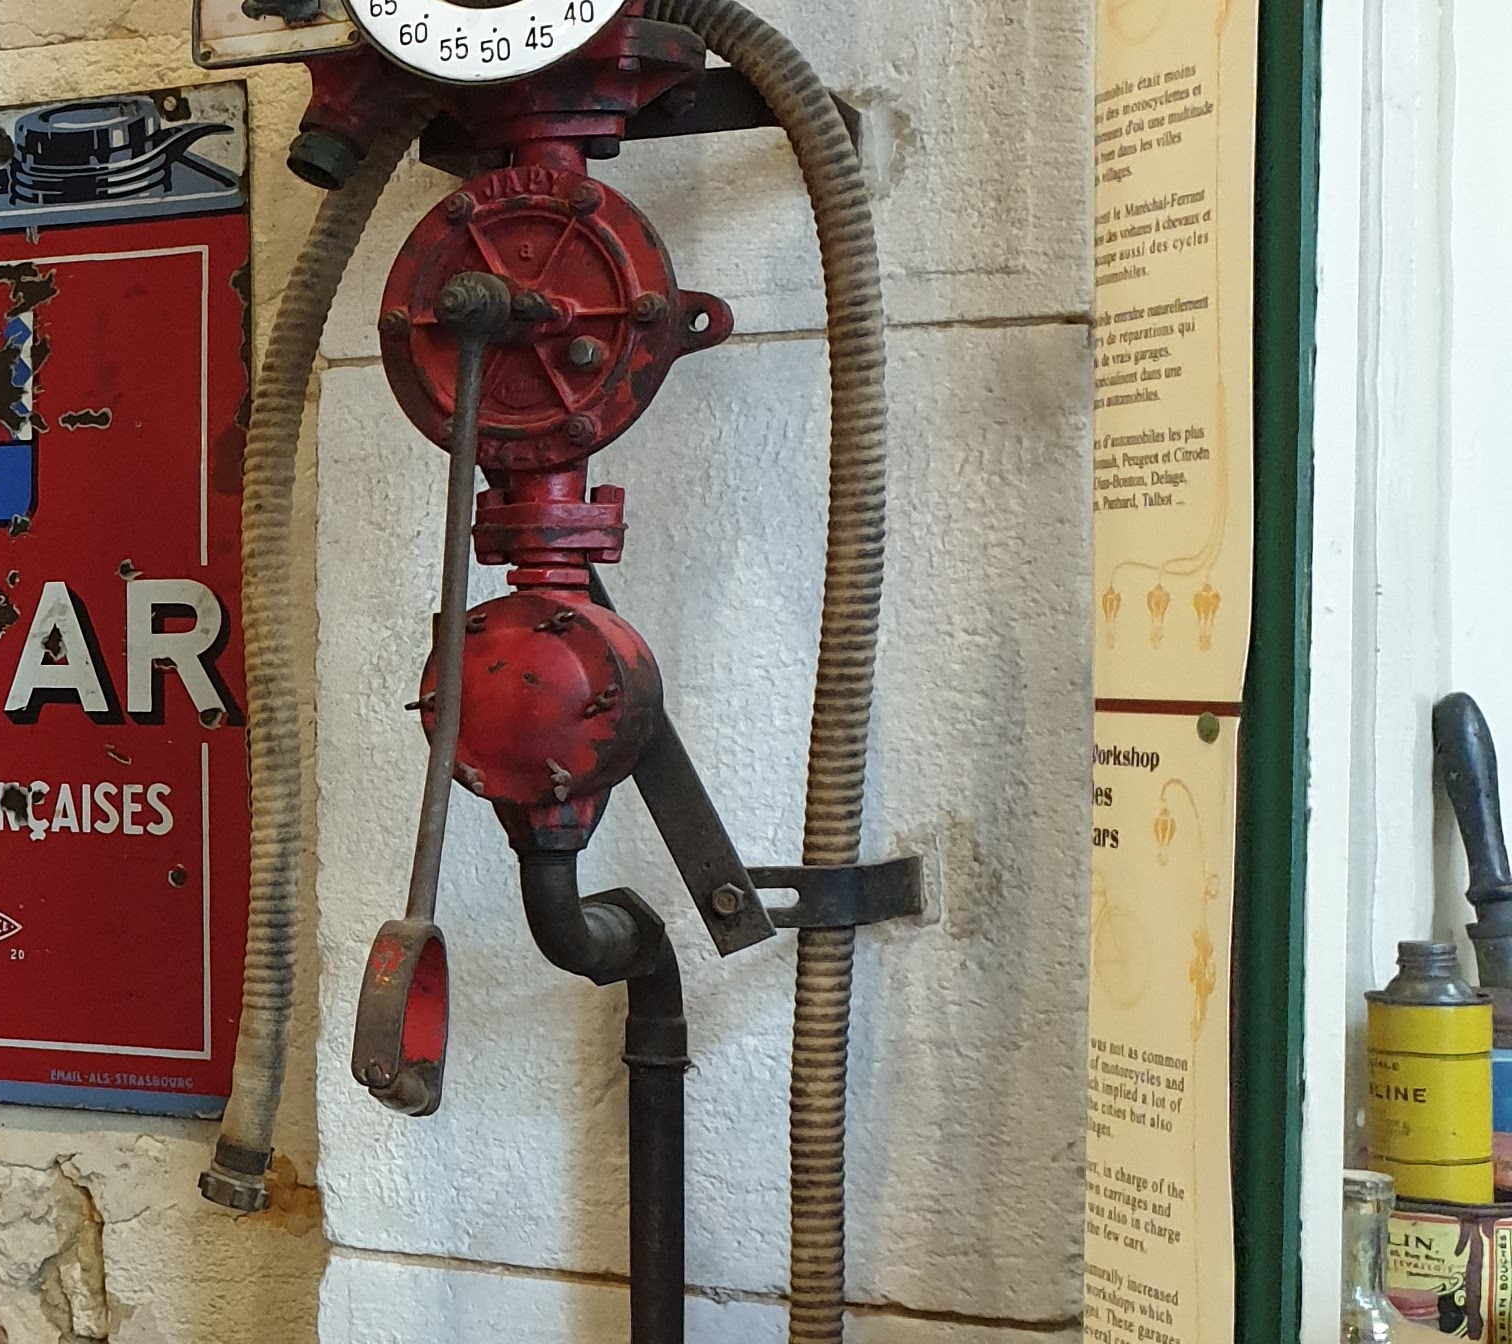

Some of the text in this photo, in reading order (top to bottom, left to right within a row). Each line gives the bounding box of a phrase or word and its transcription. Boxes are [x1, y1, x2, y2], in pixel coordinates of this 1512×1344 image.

[563, 0, 595, 24] 40
[399, 21, 429, 46] 60
[524, 24, 554, 51] 45
[439, 36, 469, 63] 55
[480, 37, 512, 64] 50
[1164, 65, 1197, 84] moins
[1149, 239, 1168, 255] des
[1172, 229, 1210, 254] cycles
[1185, 425, 1205, 444] plus
[9, 948, 26, 961] 20
[1128, 1046, 1138, 1060] as
[1142, 1051, 1188, 1071] common
[1102, 1061, 1162, 1086] motorcycles
[1166, 1076, 1185, 1093] and
[1102, 1079, 1138, 1103] implied
[1142, 1093, 1148, 1105] a
[1152, 1090, 1166, 1109] lot
[1170, 1097, 1183, 1113] of
[1101, 1102, 1172, 1133] cities but also
[1104, 1160, 1112, 1178] in
[1115, 1166, 1148, 1192] charge
[1152, 1178, 1165, 1194] of
[1168, 1181, 1185, 1200] the
[1104, 1186, 1148, 1212] carriages
[1152, 1202, 1171, 1218] and
[1104, 1223, 1120, 1243] few
[1124, 1236, 1147, 1253] cars.
[1108, 1205, 1128, 1225] also
[1131, 1216, 1141, 1230] in
[1145, 1219, 1181, 1244] charge
[1127, 1274, 1178, 1306] increased
[1106, 1307, 1134, 1333] These
[1139, 1303, 1173, 1325] which
[1085, 1325, 1112, 1344] everal
